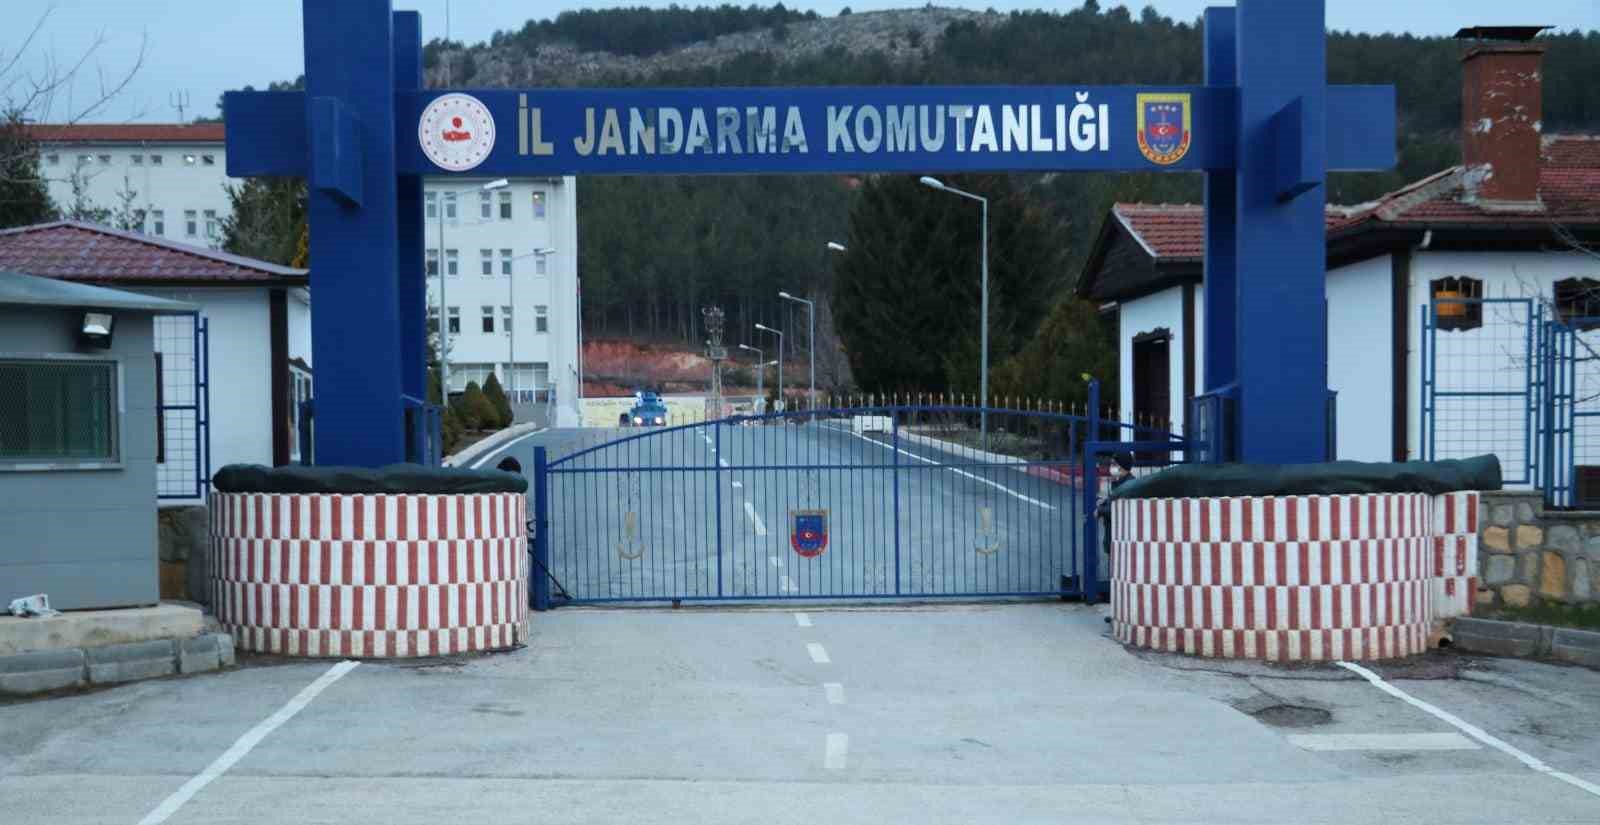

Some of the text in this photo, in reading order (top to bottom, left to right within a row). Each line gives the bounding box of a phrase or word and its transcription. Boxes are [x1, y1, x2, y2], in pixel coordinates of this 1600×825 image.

[518, 93, 554, 155] İL
[574, 106, 809, 155] JANDARMA
[826, 91, 1109, 153] KOMUTANLIĞI
